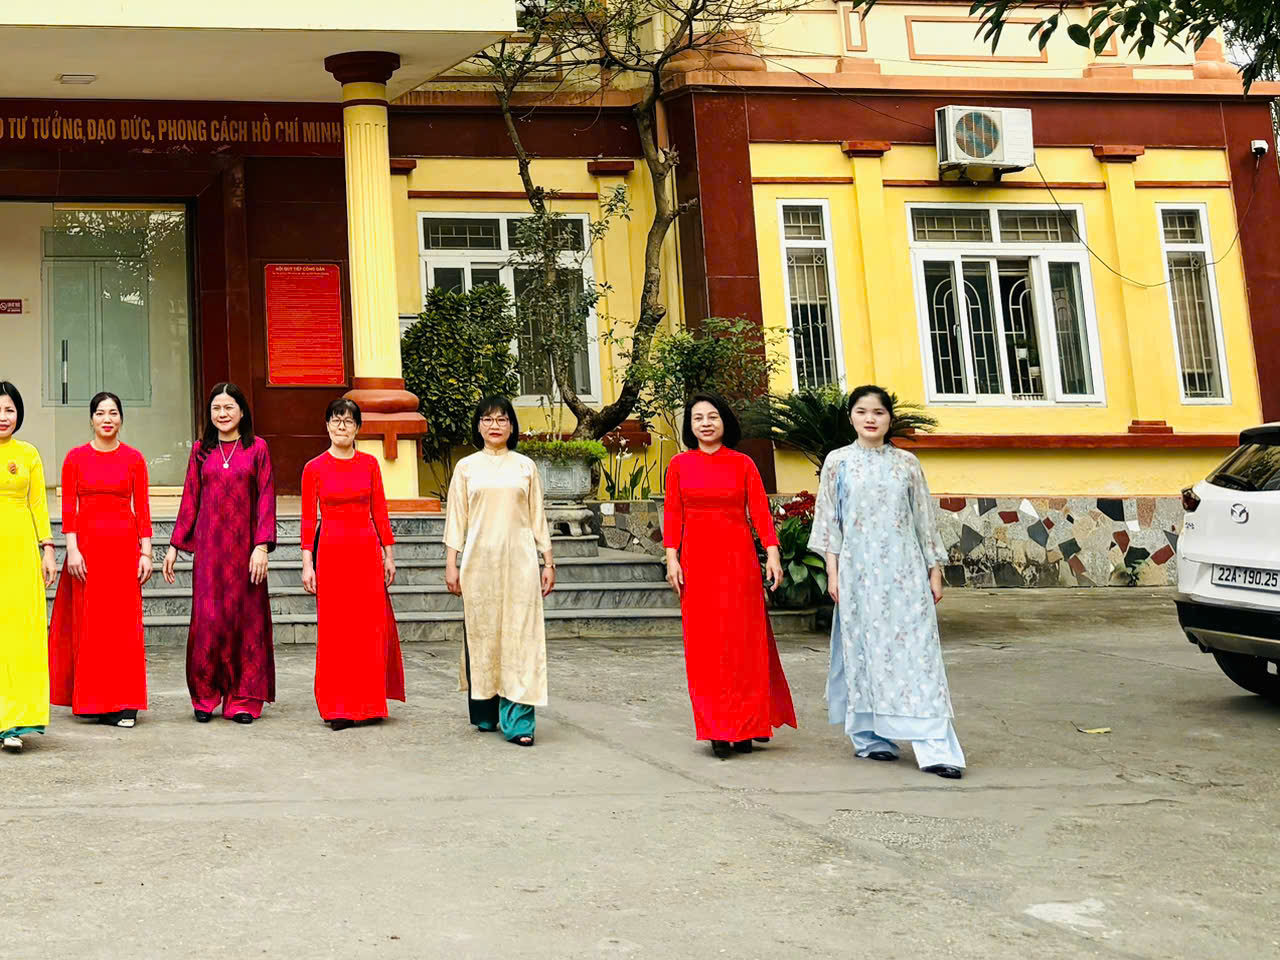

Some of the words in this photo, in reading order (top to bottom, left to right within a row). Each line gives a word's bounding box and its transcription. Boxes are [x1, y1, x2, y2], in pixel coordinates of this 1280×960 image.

[8, 115, 28, 139] TƯ
[87, 118, 116, 144] ĐẠO
[120, 114, 155, 143] ĐỨC,
[158, 119, 207, 141] PHONG
[210, 115, 248, 142] CÁCH
[252, 112, 271, 142] HỒ
[275, 117, 299, 143] CHÍ
[302, 121, 341, 143] MINH
